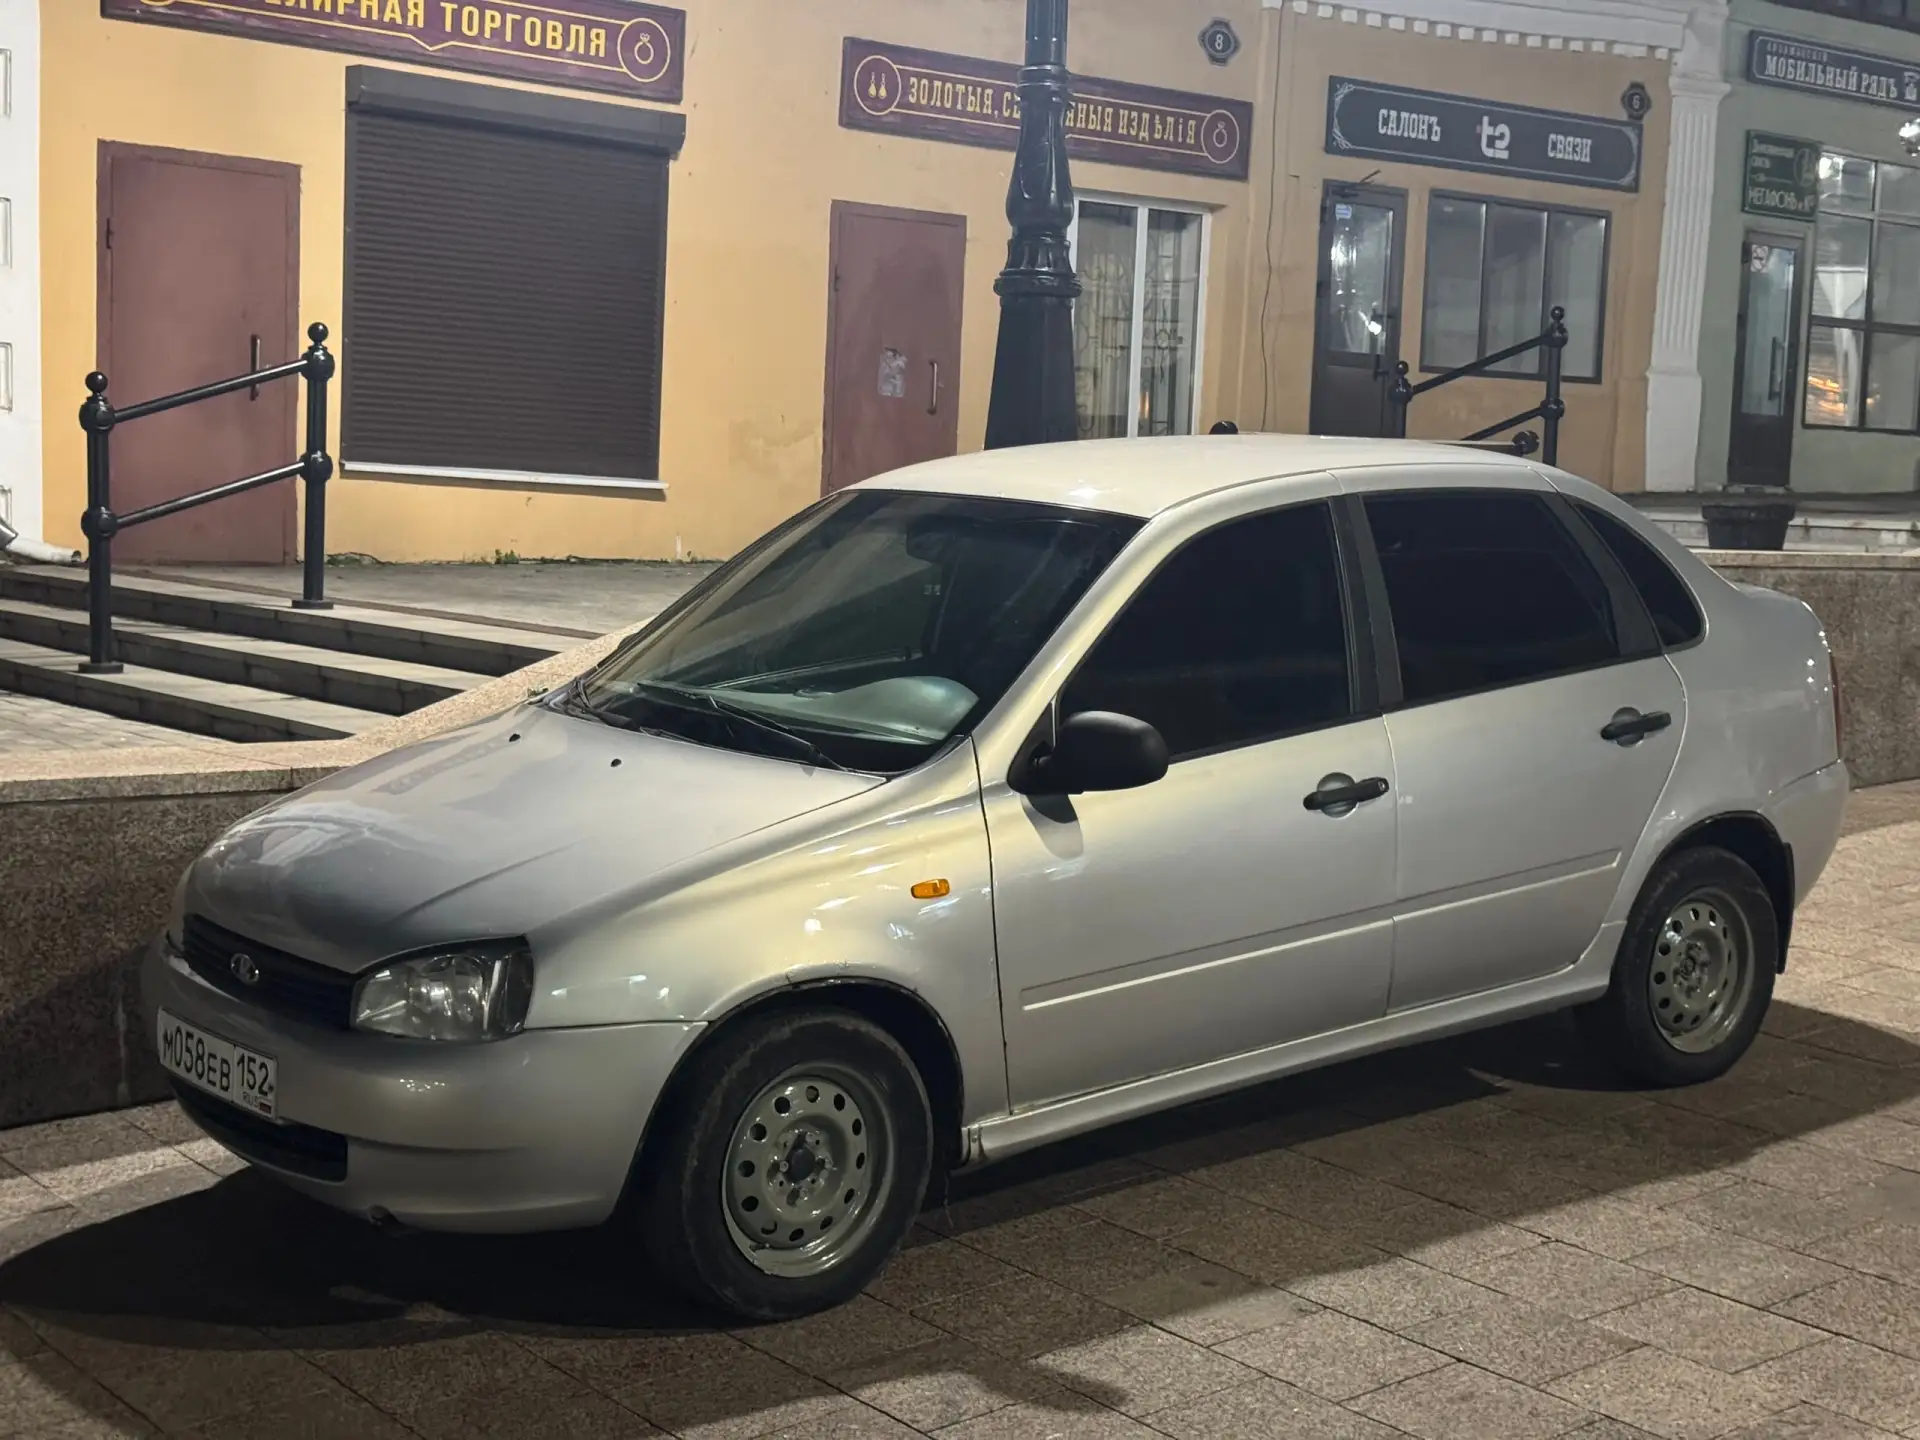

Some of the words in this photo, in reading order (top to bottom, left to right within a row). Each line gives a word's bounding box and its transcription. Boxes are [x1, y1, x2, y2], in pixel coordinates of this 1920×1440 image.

[440, 2, 606, 57] ТОРГОВЛЯ
[1214, 33, 1224, 51] 8
[909, 77, 999, 118] ЗОЛОТЫЯ,
[1764, 54, 1859, 91] МОБИЛЬНЫЙ
[1859, 72, 1898, 99] РЯДЪ
[1378, 108, 1441, 142] САЛОНЪ
[1547, 133, 1592, 163] СВЯЗИ
[237, 1053, 269, 1096] 152
